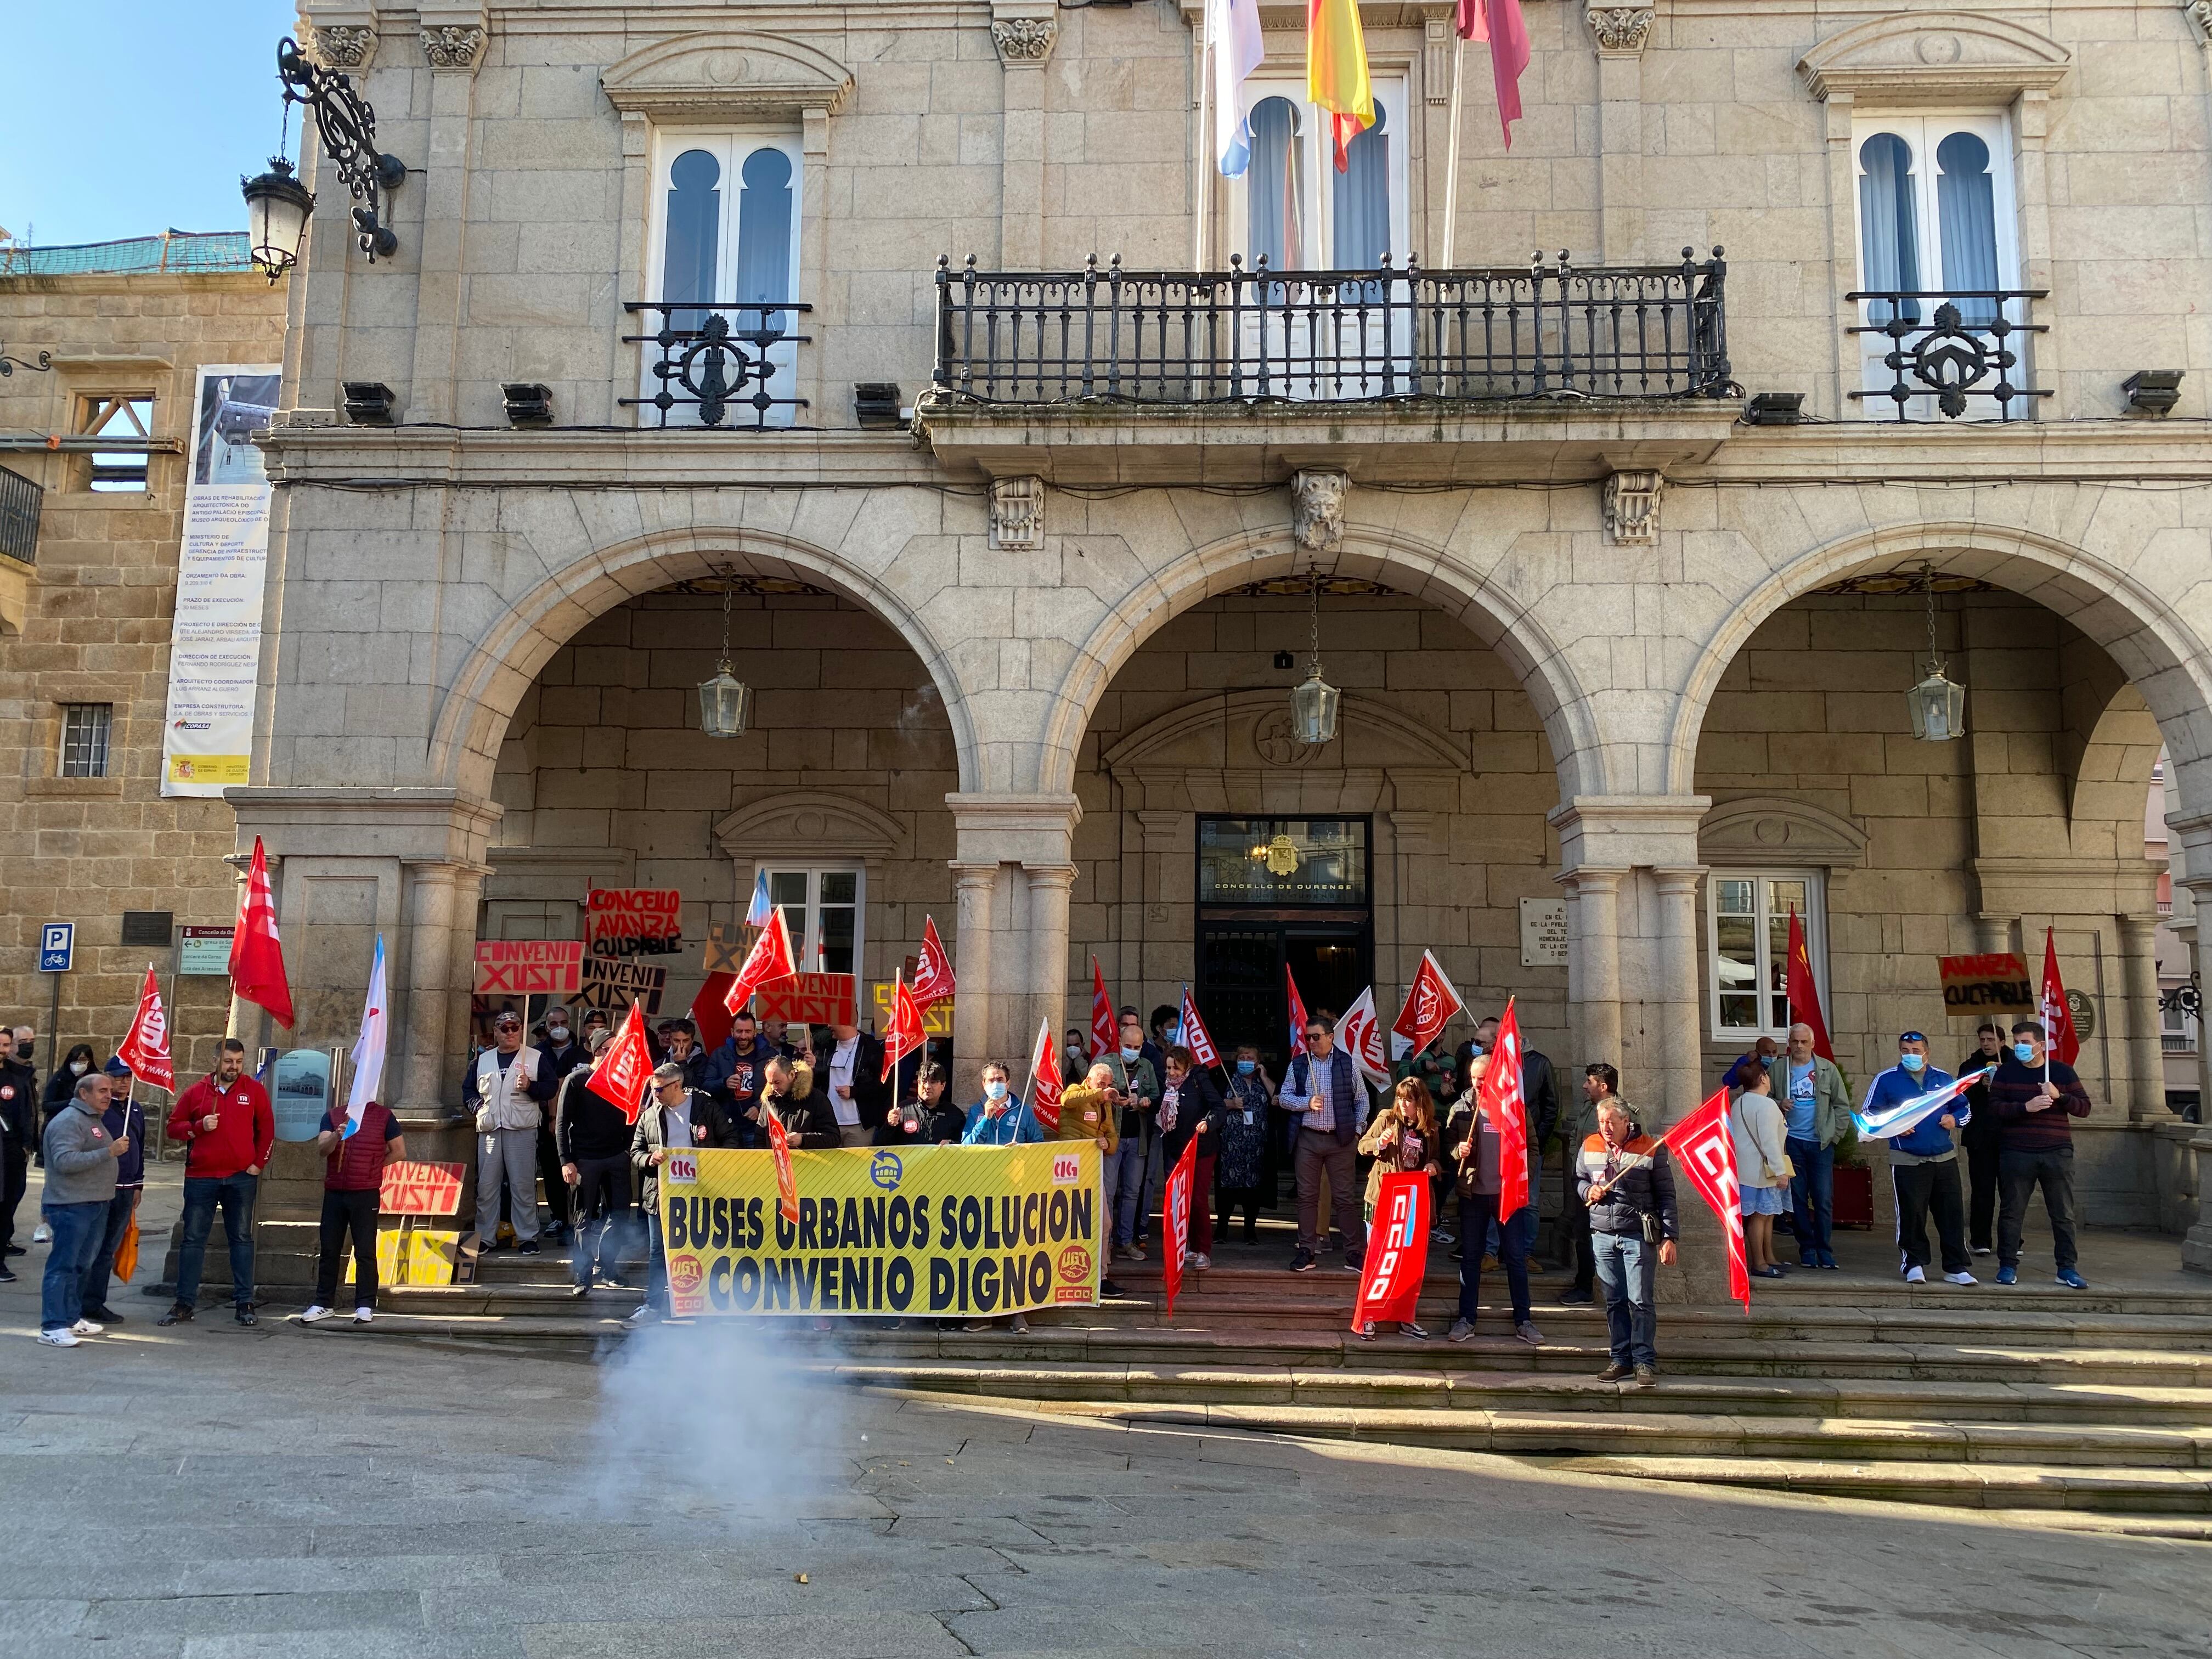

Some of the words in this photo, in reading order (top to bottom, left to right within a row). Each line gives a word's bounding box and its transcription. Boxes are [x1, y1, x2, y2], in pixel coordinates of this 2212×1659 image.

[595, 914, 680, 939] AVANZA
[50, 931, 63, 947] P
[592, 934, 682, 956] CULPABLE
[671, 1160, 696, 1177] CIG
[1054, 1161, 1077, 1177] CIG
[669, 1197, 764, 1250] BUSES
[776, 1195, 930, 1251] URBANOS
[940, 1188, 1092, 1251] SOLUCION
[1367, 1195, 1406, 1300] CCOO
[1062, 1251, 1088, 1267] UGT
[672, 1261, 699, 1277] UGT
[709, 1256, 915, 1312] CONVENIO
[930, 1250, 1052, 1312] DIGNO
[1058, 1290, 1091, 1300] CCOO
